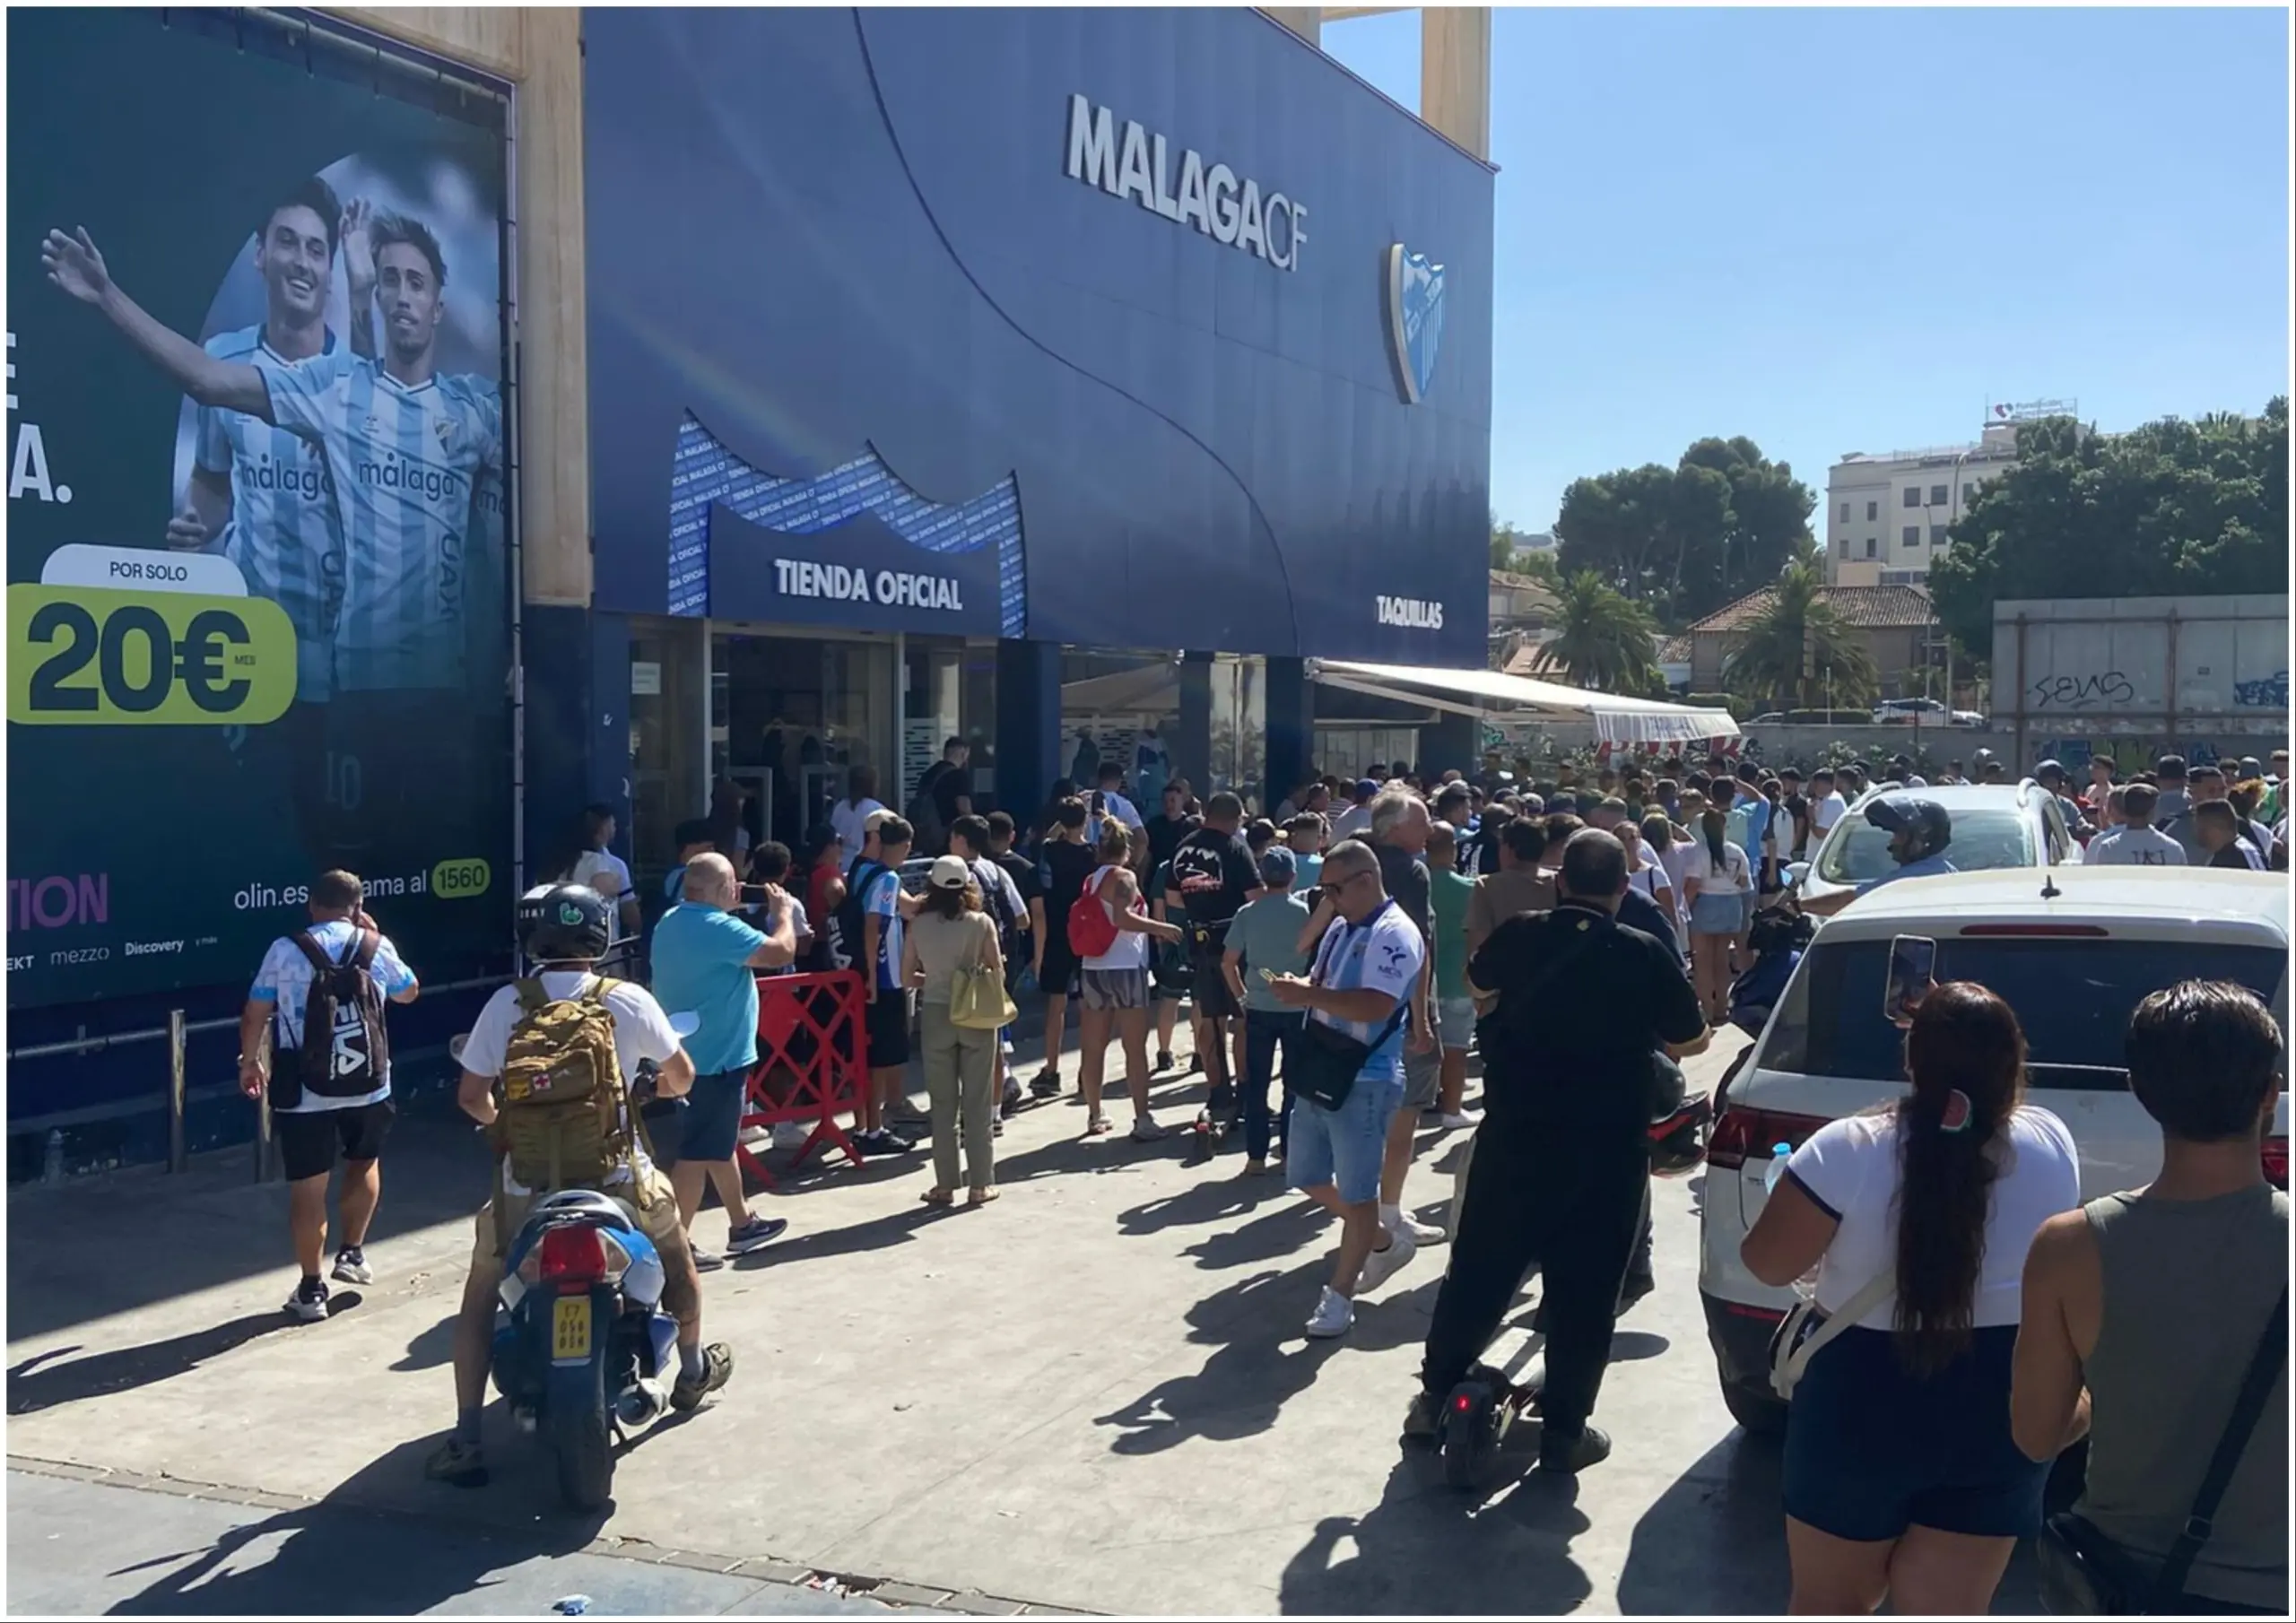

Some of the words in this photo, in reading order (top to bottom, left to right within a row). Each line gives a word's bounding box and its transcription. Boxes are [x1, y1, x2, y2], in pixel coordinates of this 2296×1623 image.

[109, 561, 143, 579] POR
[146, 563, 187, 582] SOLO
[775, 559, 870, 602] TIENDA
[875, 570, 962, 611] OFICIAL
[1376, 595, 1443, 630] TAQUILLAS
[28, 602, 253, 713] 20€
[234, 882, 309, 910] olin.es
[361, 875, 404, 898] ama
[411, 869, 427, 893] al
[438, 864, 486, 890] 1560
[50, 946, 109, 966] mezzo
[125, 938, 185, 956] Discovery
[333, 1001, 366, 1075] FILA
